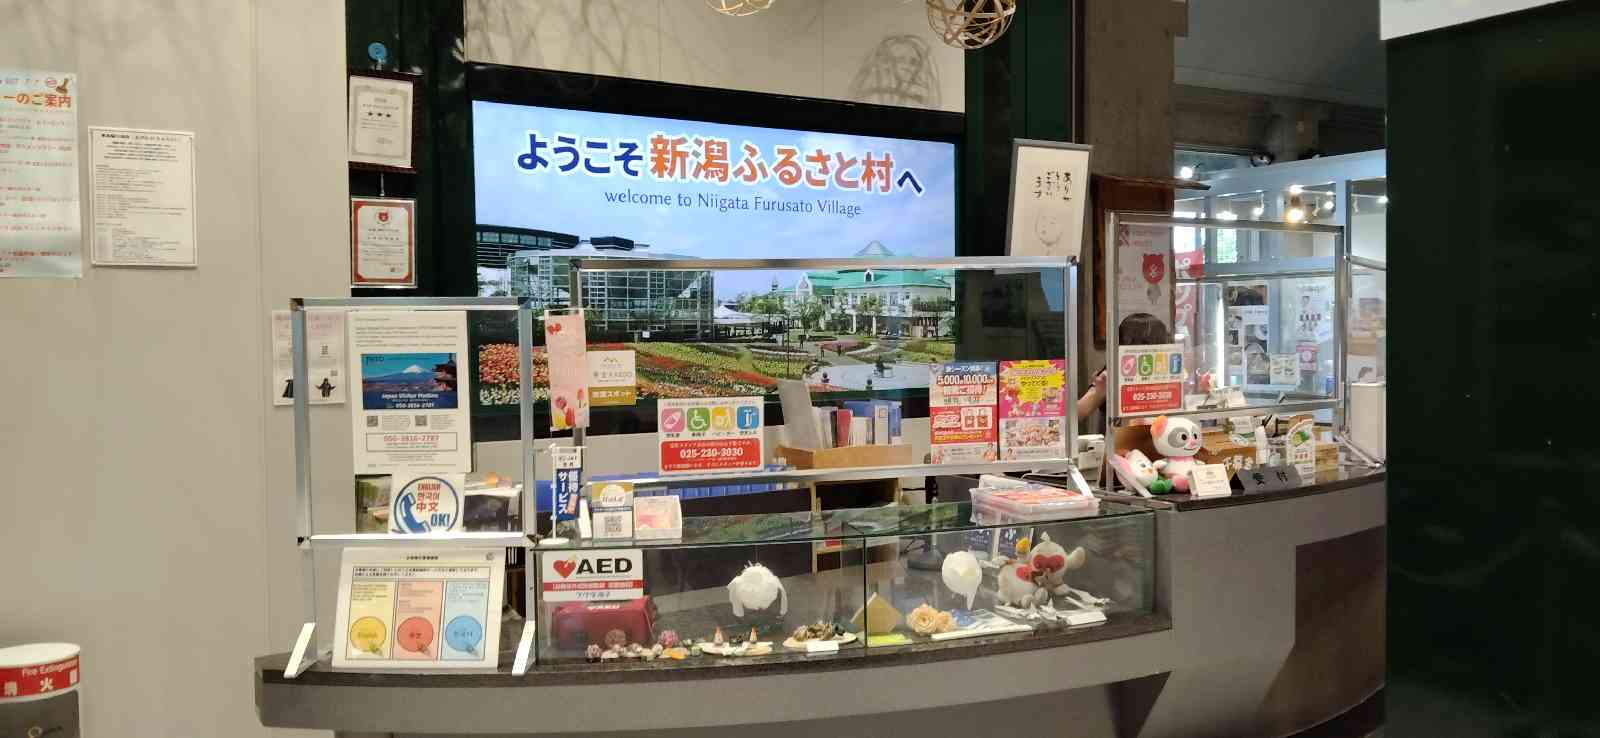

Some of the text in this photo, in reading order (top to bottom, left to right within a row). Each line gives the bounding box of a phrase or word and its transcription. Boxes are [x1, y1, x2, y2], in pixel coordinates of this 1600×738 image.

[516, 133, 923, 195] ようこそ新潟ふるさと村へ
[604, 189, 861, 217] welcome to Niigata Furusato Village
[416, 502, 439, 513] 中文
[576, 558, 633, 575] AED
